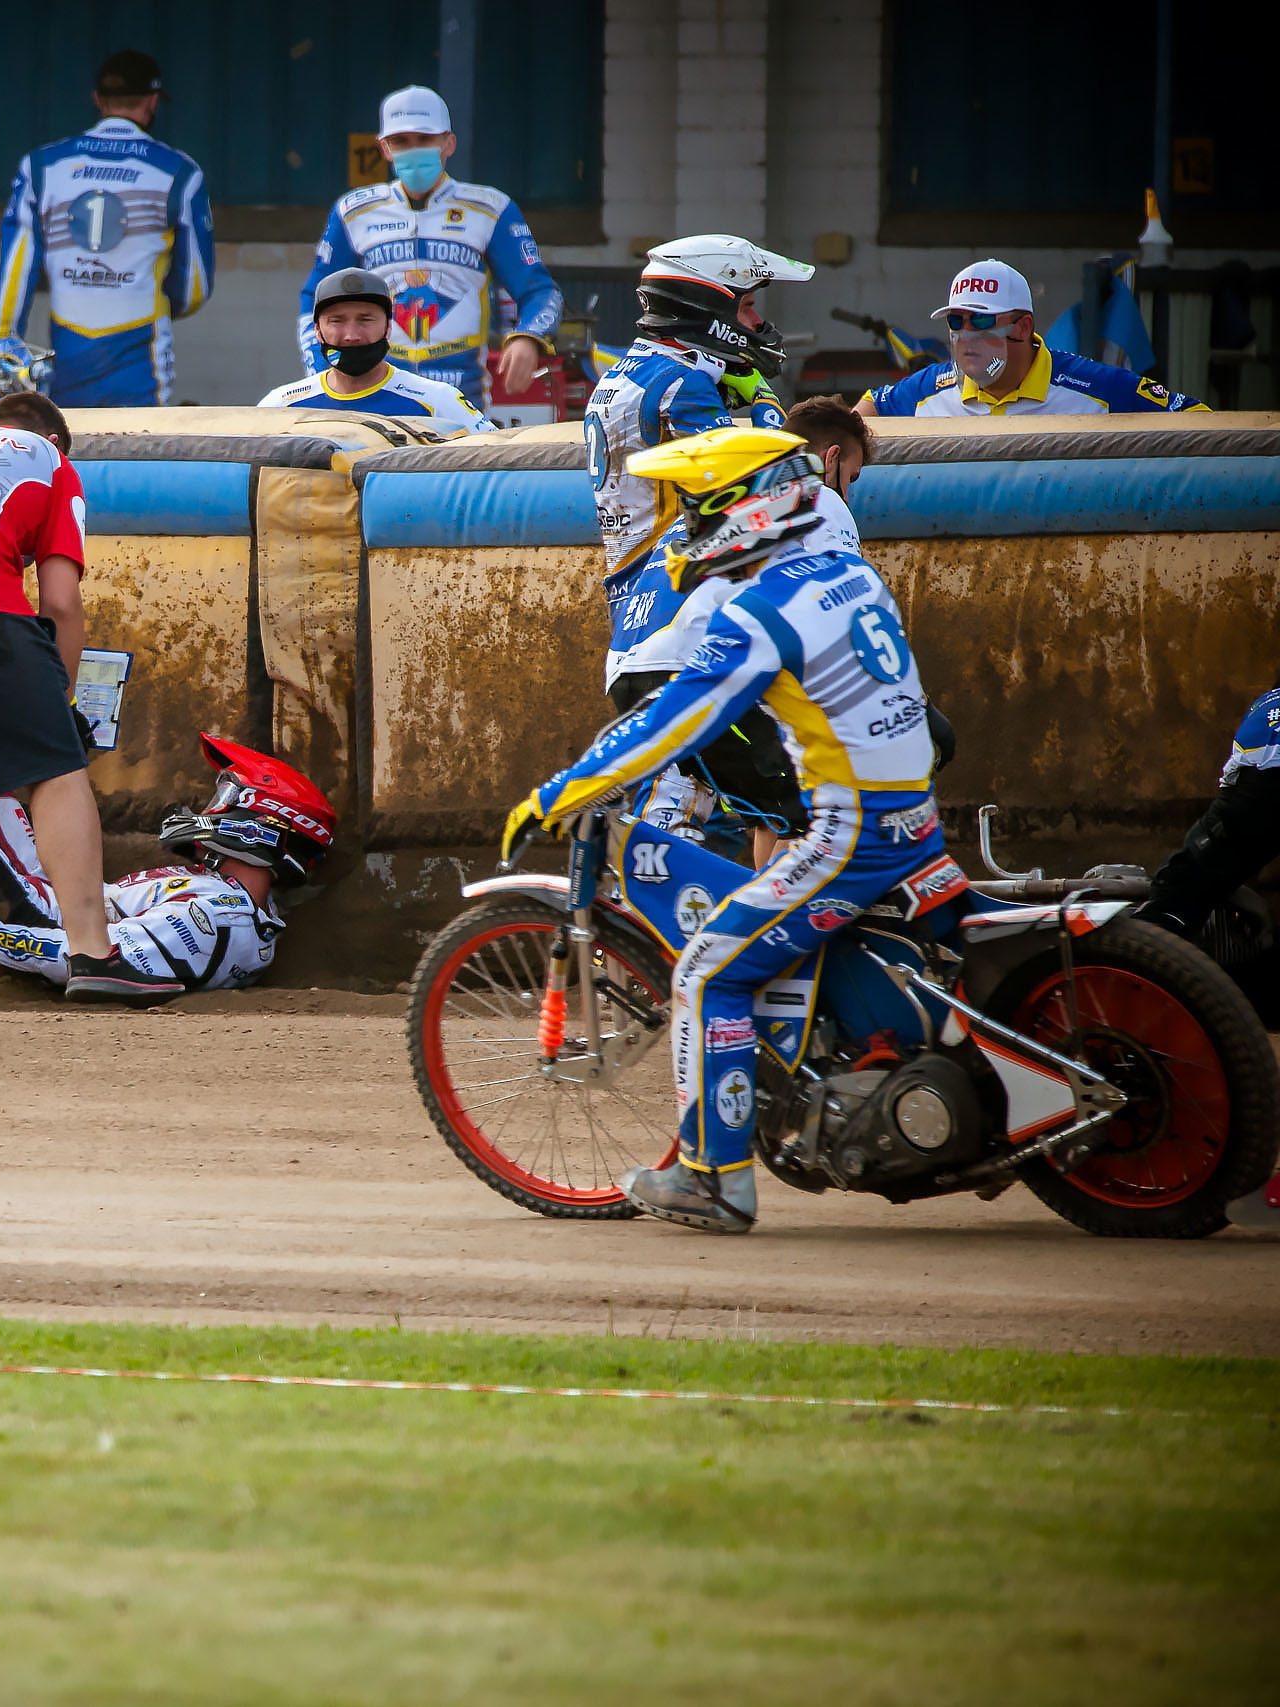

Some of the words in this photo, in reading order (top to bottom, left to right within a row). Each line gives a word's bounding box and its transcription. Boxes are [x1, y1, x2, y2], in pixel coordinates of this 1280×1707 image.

[87, 197, 106, 249] 1
[750, 268, 775, 279] Nice
[708, 319, 748, 348] Nice
[586, 423, 598, 476] 2
[860, 611, 902, 684] 5
[256, 798, 333, 846] SCOT
